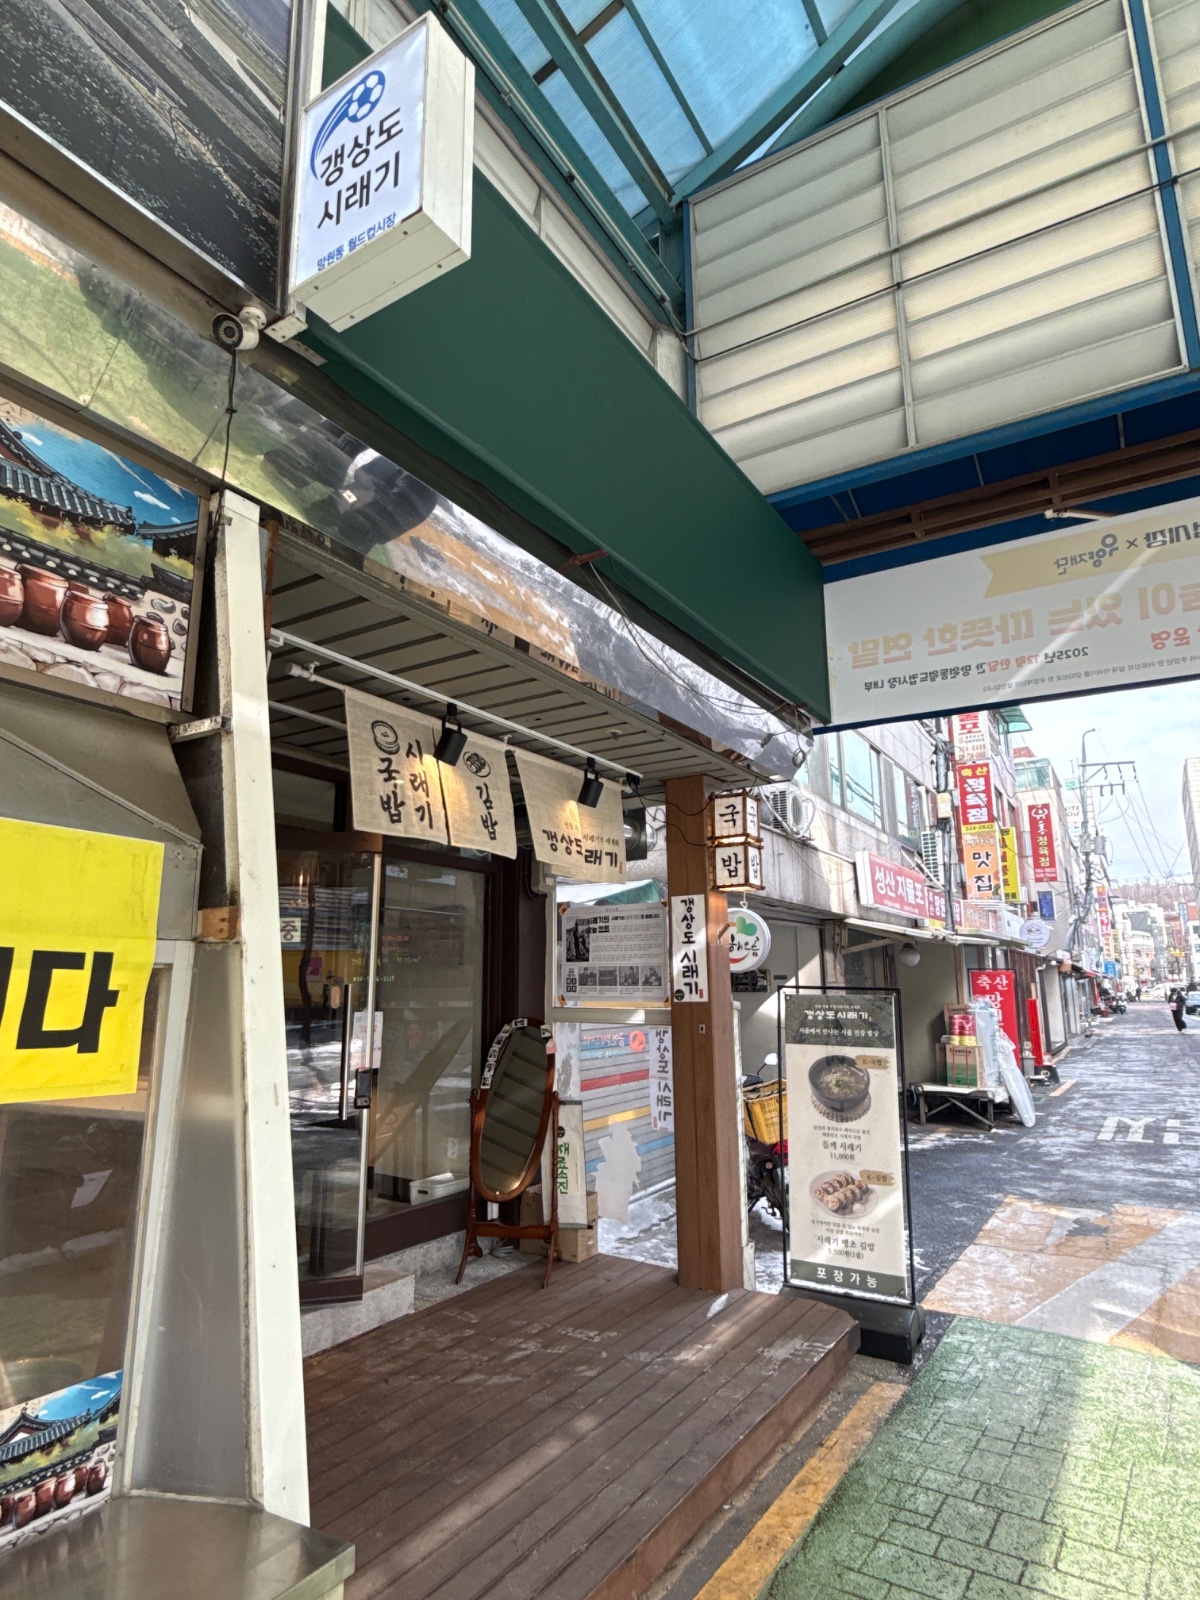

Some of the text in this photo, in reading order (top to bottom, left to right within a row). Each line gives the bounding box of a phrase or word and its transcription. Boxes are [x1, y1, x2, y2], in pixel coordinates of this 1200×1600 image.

[320, 107, 403, 187] 갱상도
[317, 150, 400, 229] 시래기
[317, 211, 397, 271] 망원동 월드컵시장
[377, 739, 434, 830] 시래기 국밥
[961, 766, 988, 777] 축산
[475, 782, 498, 841] 김밥
[963, 777, 989, 823] 정육점
[1036, 835, 1050, 867] 정육점
[874, 865, 925, 905] 성산 지물포
[972, 851, 993, 892] 맛집
[680, 896, 699, 996] 갱상도 시래기
[0, 946, 120, 1054] 다
[976, 974, 1009, 990] 축산
[804, 1009, 869, 1021] 갱상도시래기
[822, 1140, 862, 1153] 들깨 시래기
[830, 1152, 855, 1161] 11,000원
[867, 1173, 888, 1183] K-김밥
[816, 1235, 839, 1246] 시래기
[859, 1241, 875, 1252] 김밥
